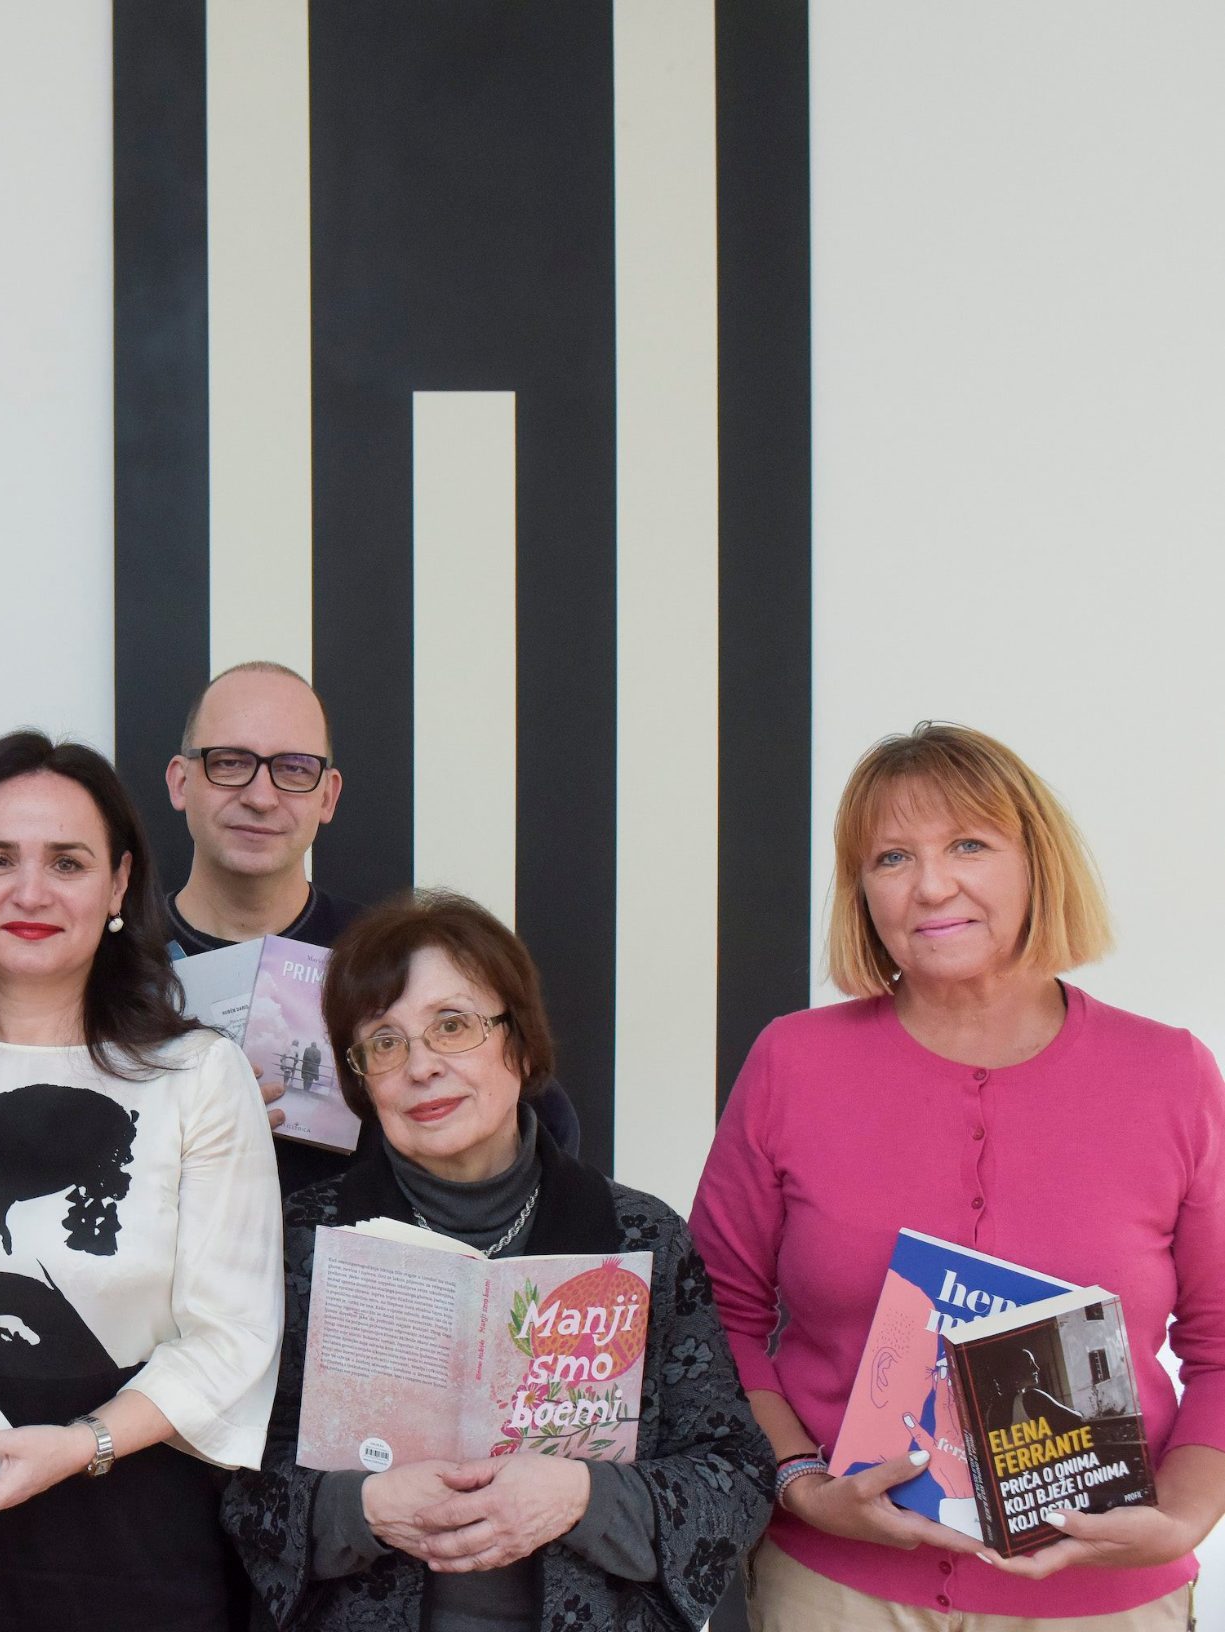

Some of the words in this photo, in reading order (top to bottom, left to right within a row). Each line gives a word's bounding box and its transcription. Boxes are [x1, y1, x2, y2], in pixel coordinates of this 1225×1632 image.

[515, 1294, 641, 1347] Manji
[528, 1351, 614, 1385] smo
[508, 1388, 623, 1429] boemi
[988, 1416, 1053, 1453] ELENA
[993, 1425, 1095, 1477] FERRANTE
[999, 1471, 1043, 1498] PRIČA
[1042, 1467, 1054, 1483] O
[1054, 1452, 1100, 1478] ONIMA
[1003, 1493, 1036, 1516] KOJI
[1035, 1477, 1076, 1505] BJEŽE
[1077, 1475, 1084, 1490] I
[1084, 1460, 1130, 1488] ONIMA
[1124, 1490, 1143, 1503] PROFIL
[1007, 1510, 1039, 1534] KOJI
